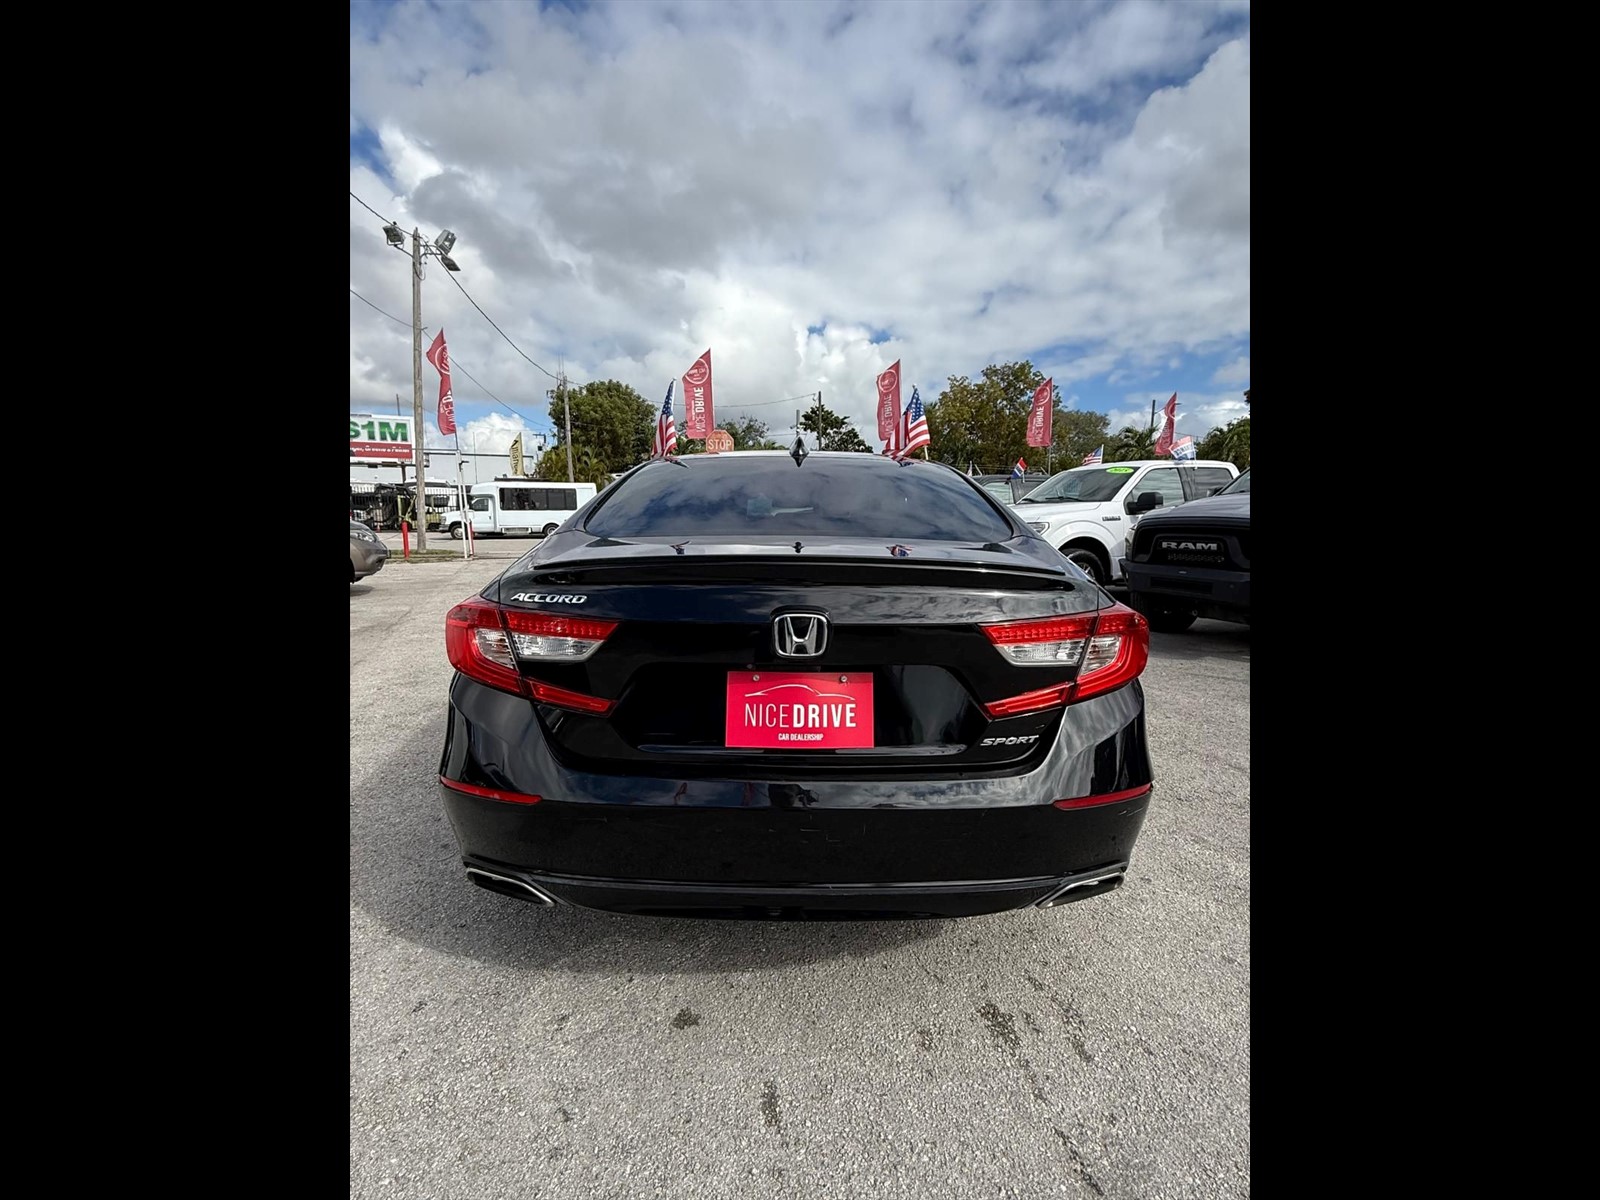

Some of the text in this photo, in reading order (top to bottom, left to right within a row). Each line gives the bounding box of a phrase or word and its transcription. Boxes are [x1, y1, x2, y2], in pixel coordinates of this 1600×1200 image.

[708, 439, 732, 450] STOP
[1162, 541, 1218, 551] RAM
[510, 592, 588, 604] ACCORD
[778, 733, 824, 741] CAR DEALERSHIP
[980, 734, 1039, 746] SPORT
